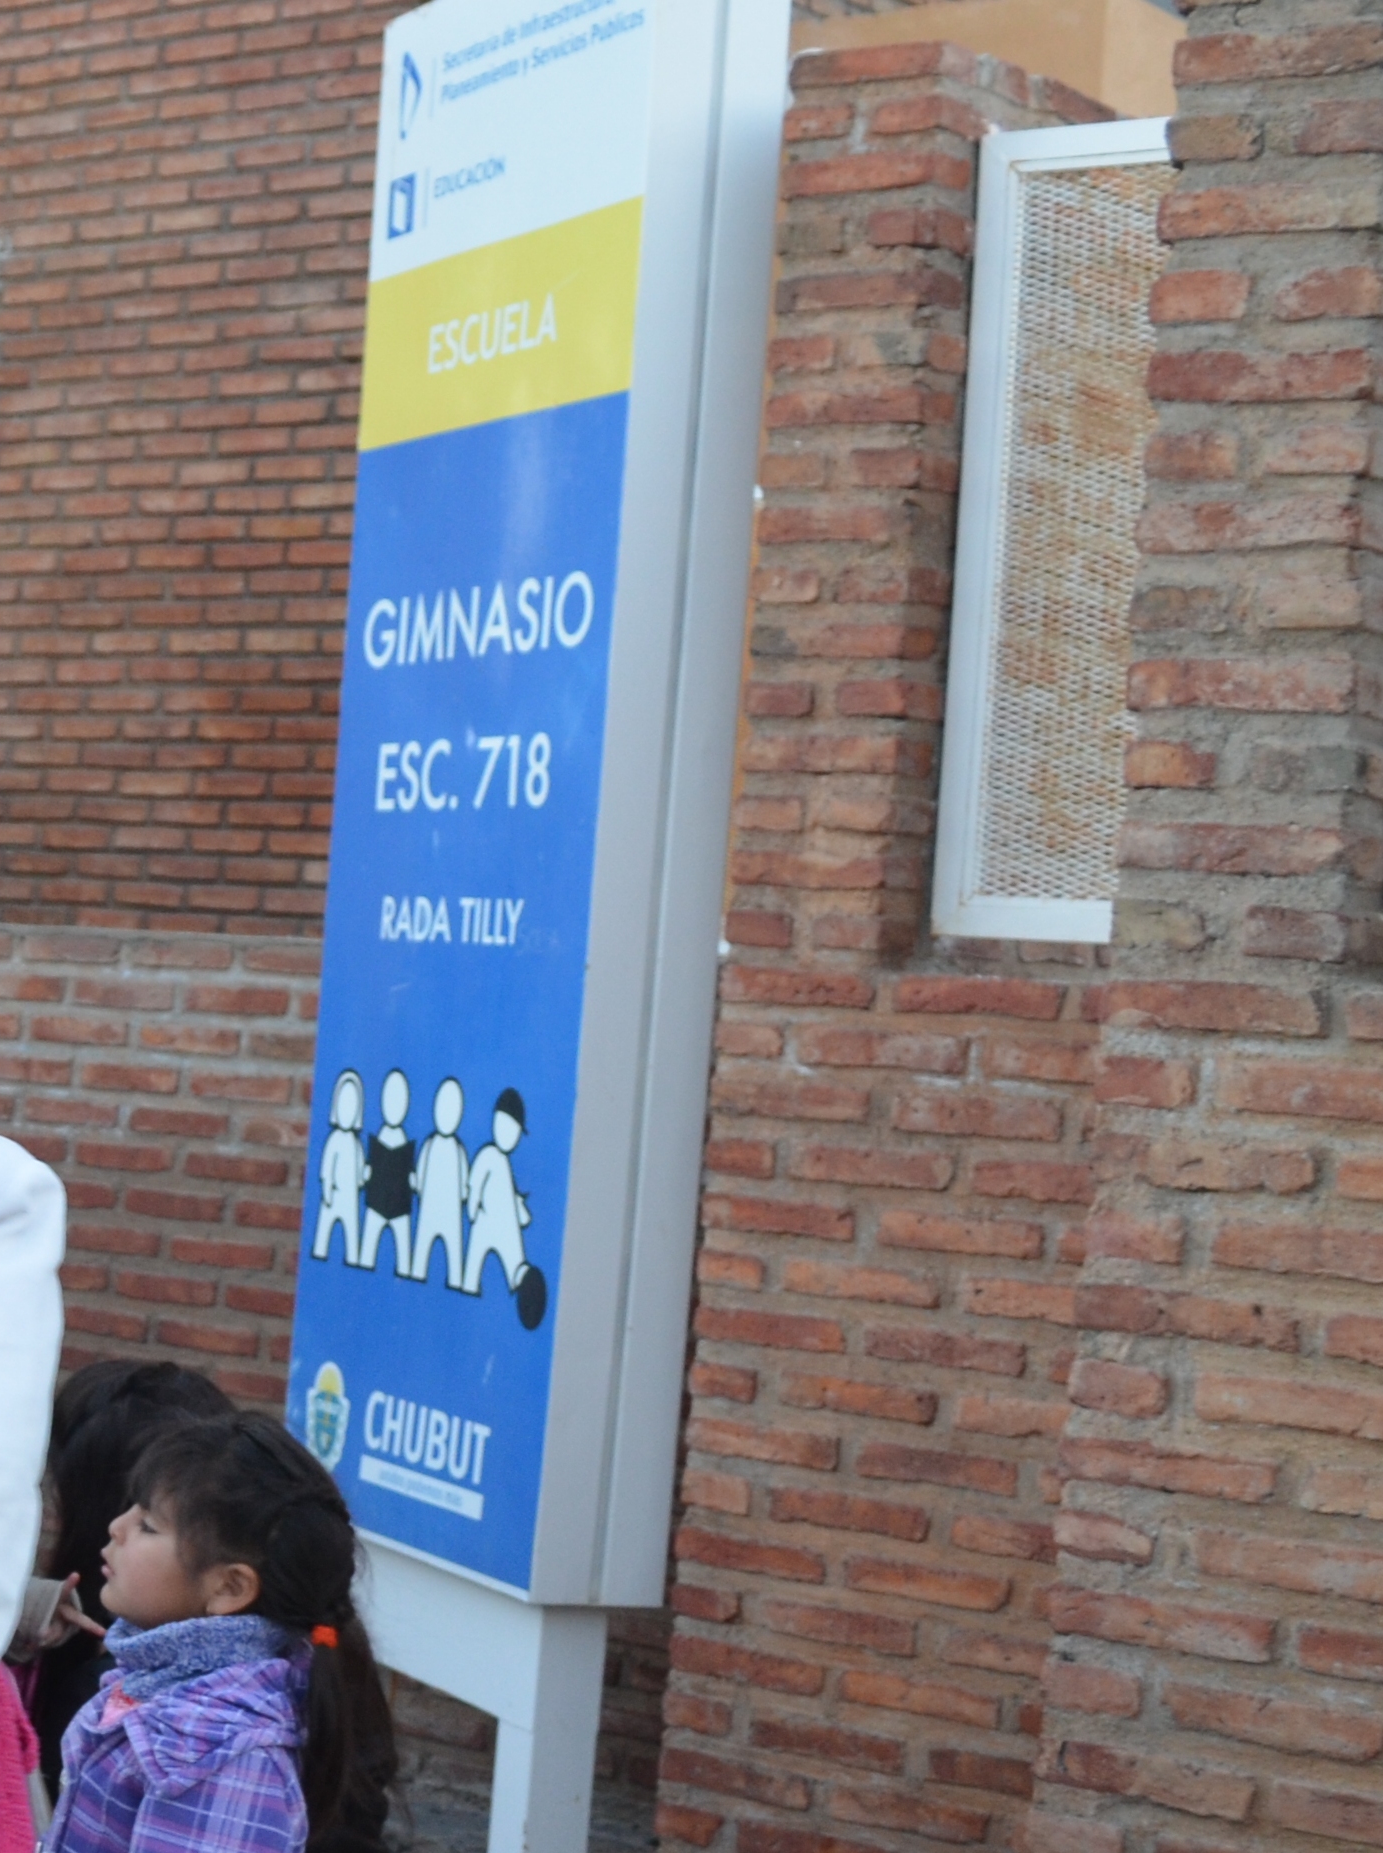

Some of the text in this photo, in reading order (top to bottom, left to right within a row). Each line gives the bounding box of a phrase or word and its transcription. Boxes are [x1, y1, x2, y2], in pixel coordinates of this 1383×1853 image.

[440, 58, 519, 103] Planeamiento
[531, 32, 587, 68] Servicios
[428, 292, 558, 375] ESCUELA
[363, 570, 594, 670] GIMNASIO
[374, 731, 552, 812] ESC. 718
[379, 895, 525, 946] RADA TILLY
[364, 1390, 492, 1486] CHUBUT
